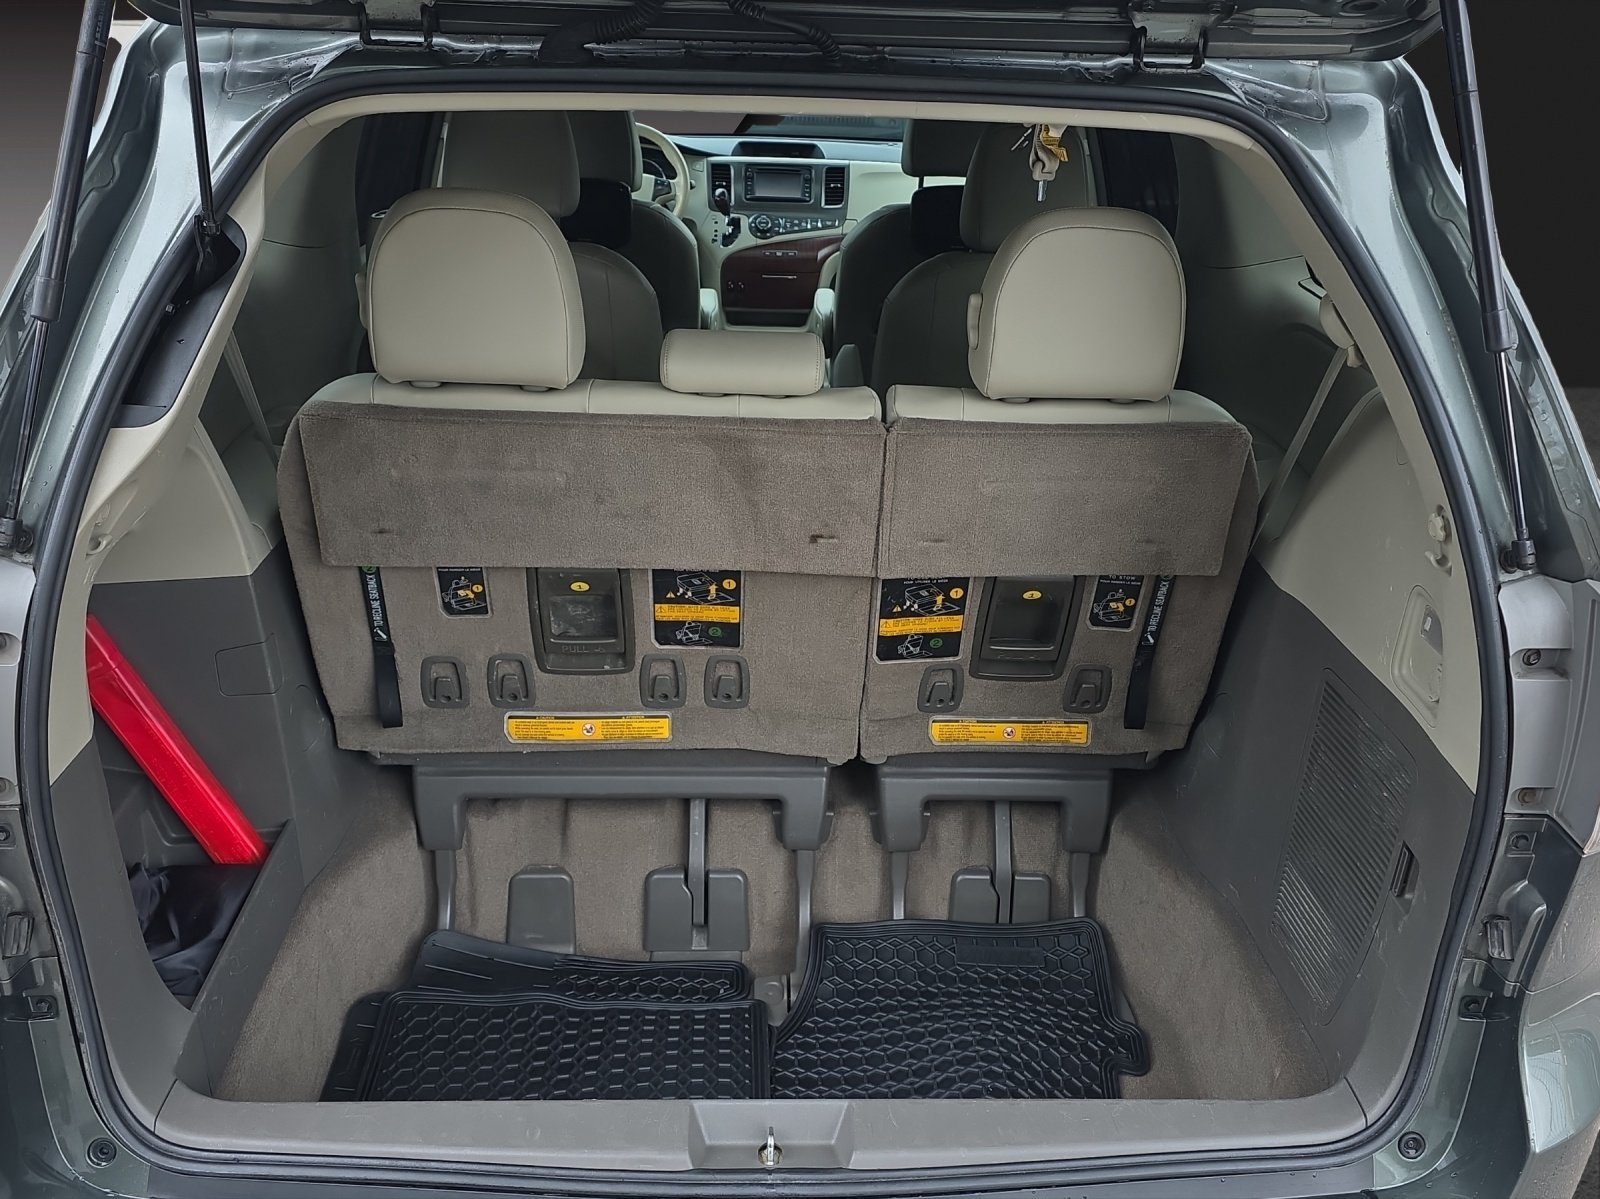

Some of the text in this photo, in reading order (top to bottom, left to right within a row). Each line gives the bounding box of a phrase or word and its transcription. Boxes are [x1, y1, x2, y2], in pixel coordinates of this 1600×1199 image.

[365, 574, 380, 600] SEATBACK
[1154, 580, 1170, 606] SEATBACK
[370, 600, 383, 620] RECLINE
[1149, 605, 1163, 626] RECLINE
[561, 644, 589, 653] PULL
